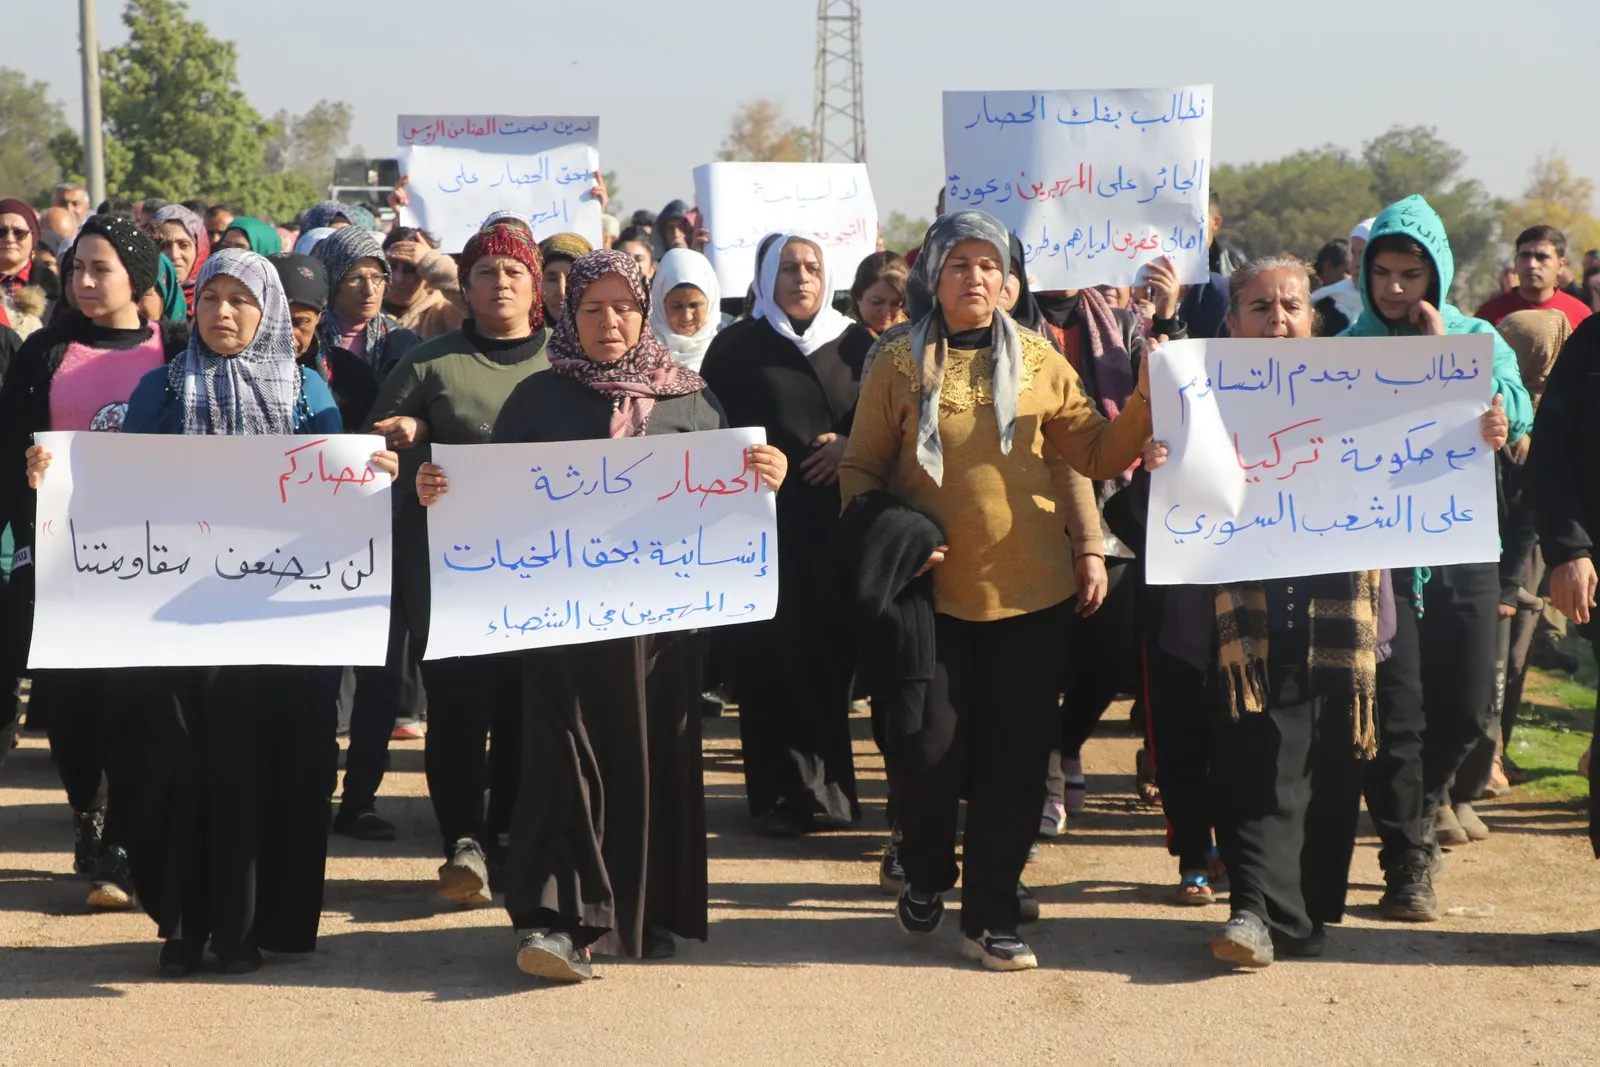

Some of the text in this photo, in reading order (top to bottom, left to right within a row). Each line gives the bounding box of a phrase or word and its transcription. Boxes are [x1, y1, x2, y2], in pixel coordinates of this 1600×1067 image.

[965, 90, 1205, 132] نطالب بفك الحصار
[438, 164, 479, 193] على
[490, 156, 548, 189] الحصار
[1017, 162, 1092, 202] المهجرين
[1097, 166, 1137, 197] على
[1137, 159, 1204, 203] الجائر
[1112, 229, 1159, 259] عفرين
[1288, 363, 1361, 407] بعدم
[1375, 352, 1479, 395] نطالب
[279, 438, 376, 504] حصاركم
[1234, 418, 1477, 483] مع حكومة تركيا
[530, 447, 760, 508] الحصار كارثة
[1164, 491, 1474, 546] على الشعب السوري
[214, 546, 331, 588] يضعف
[340, 537, 375, 591] لن
[443, 525, 768, 579] إنسانية بحق المخيمات
[588, 601, 617, 632] في
